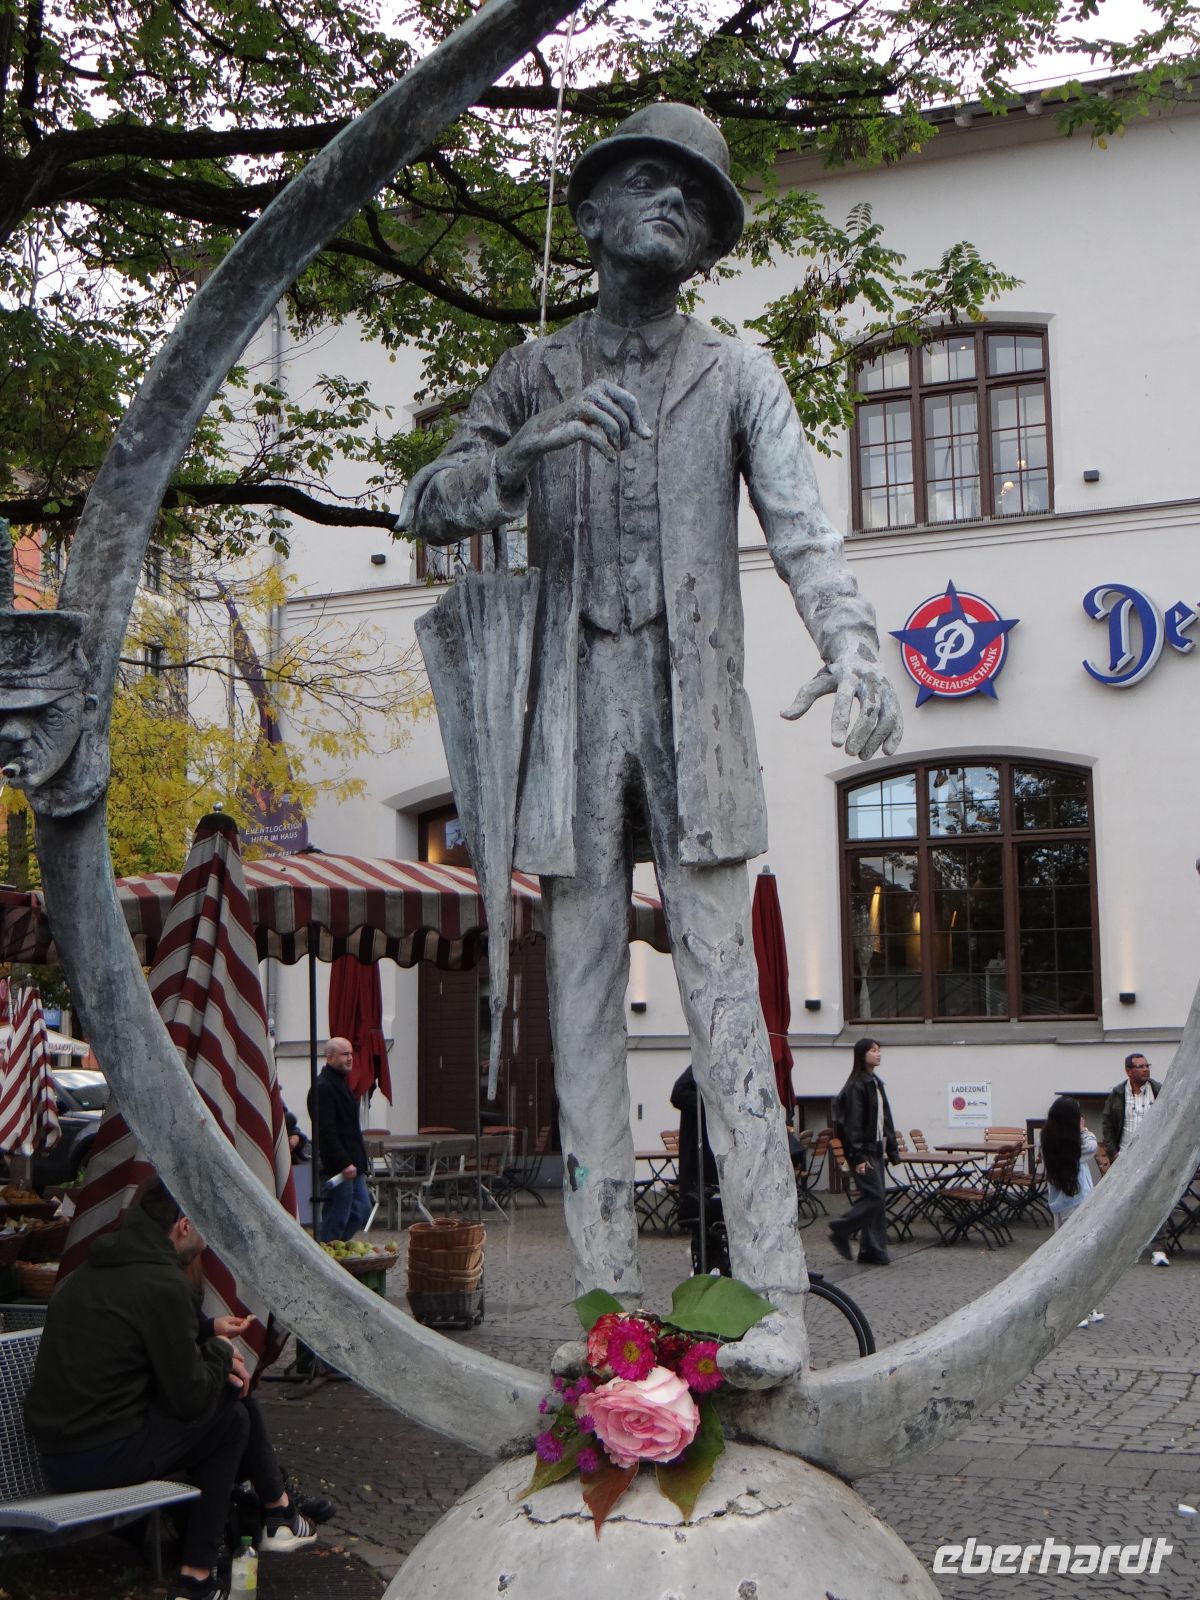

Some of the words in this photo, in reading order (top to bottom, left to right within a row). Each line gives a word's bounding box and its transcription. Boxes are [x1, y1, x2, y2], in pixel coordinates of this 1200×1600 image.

[1082, 583, 1200, 687] De
[909, 647, 998, 690] BRAUEREIAUSSCHANK
[251, 835, 269, 843] HIER
[280, 832, 298, 840] HAUS
